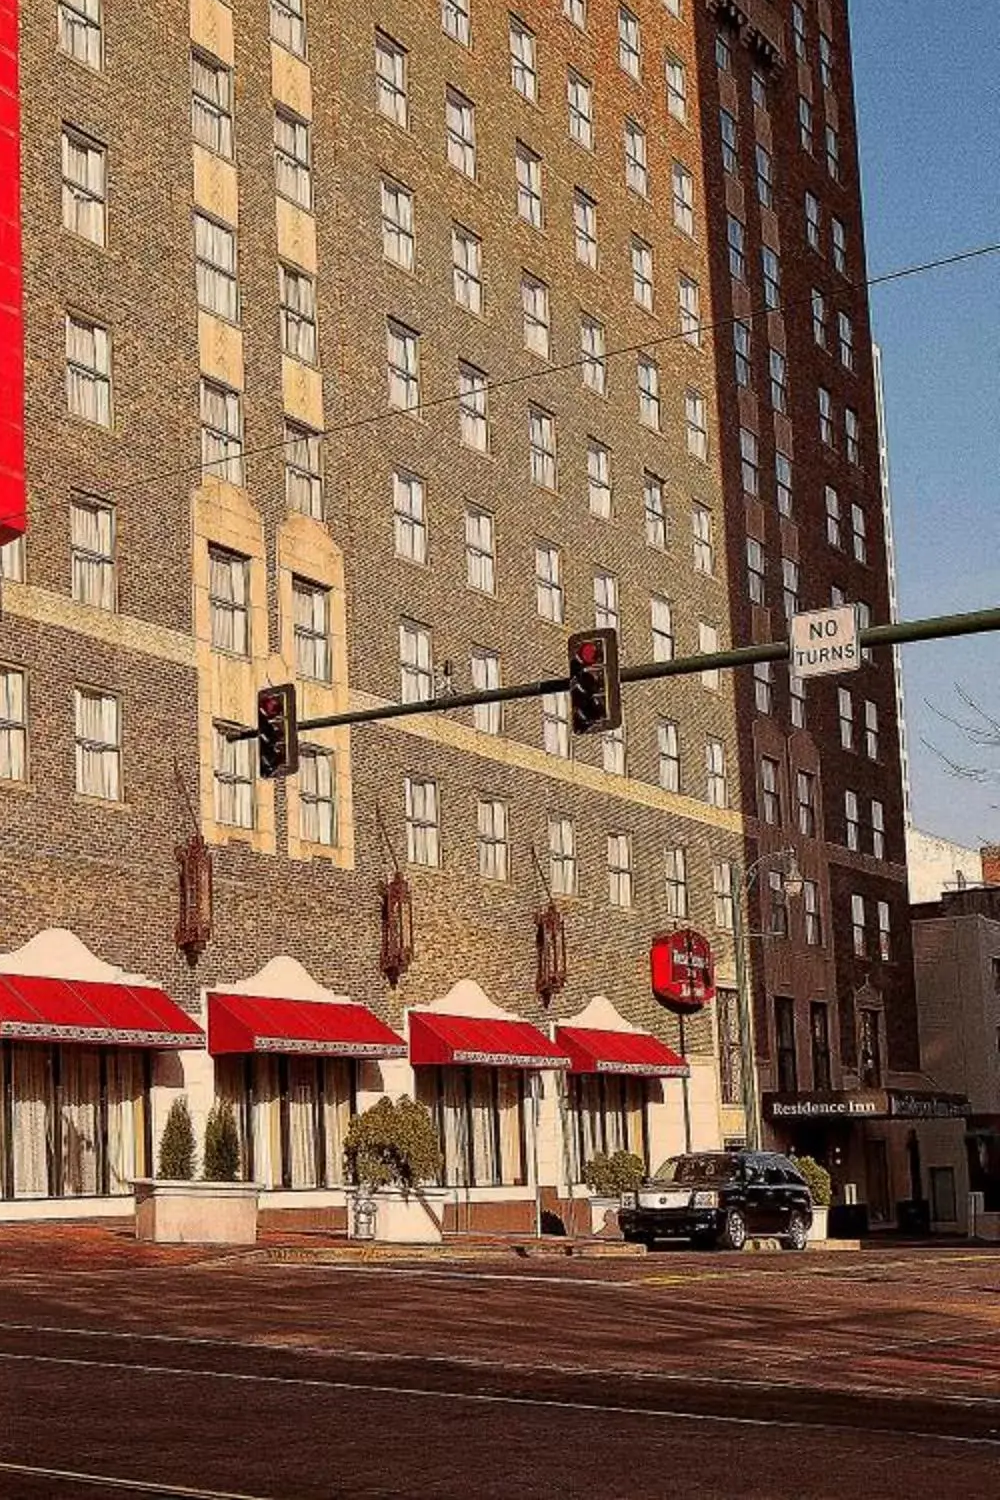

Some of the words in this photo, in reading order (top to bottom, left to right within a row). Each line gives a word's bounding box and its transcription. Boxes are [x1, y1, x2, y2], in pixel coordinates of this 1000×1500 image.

[809, 619, 838, 640] NO
[796, 643, 855, 667] TURNS
[772, 1102, 846, 1116] Residence
[849, 1100, 876, 1113] Inn
